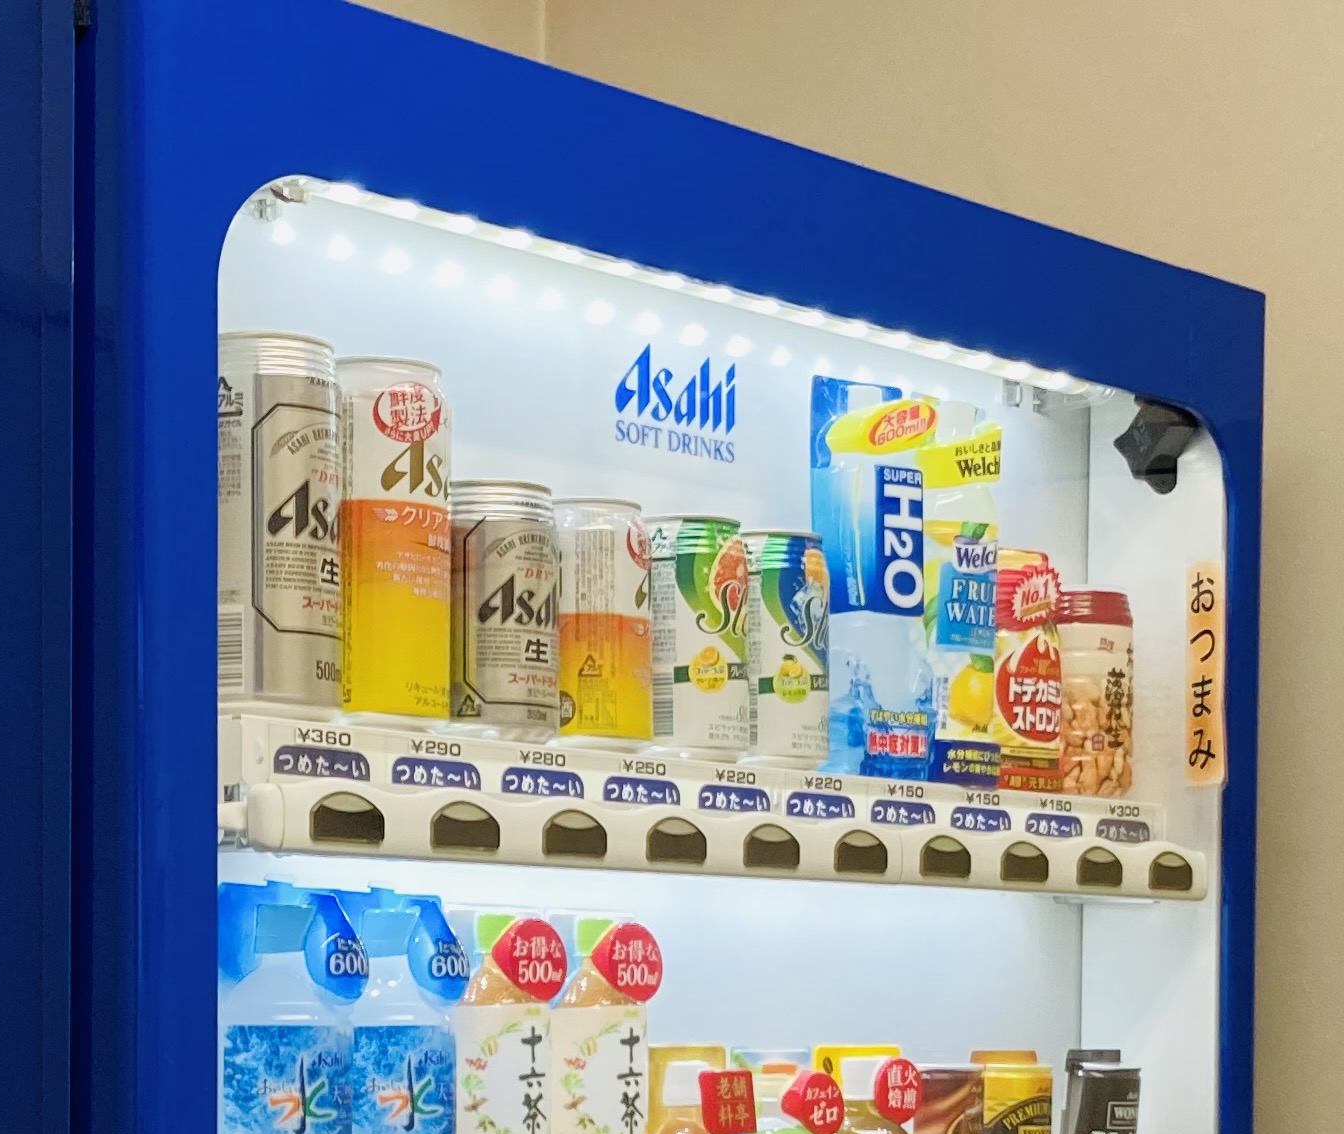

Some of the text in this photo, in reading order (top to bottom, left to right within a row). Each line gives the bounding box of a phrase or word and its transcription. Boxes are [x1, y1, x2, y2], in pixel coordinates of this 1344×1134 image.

[614, 343, 736, 435] Asahi
[883, 404, 920, 430] 大容量
[614, 419, 735, 463] SOFT DRINKS
[381, 440, 449, 500] As
[525, 638, 549, 664] 生
[1189, 572, 1216, 769] おつまみ
[297, 727, 352, 747] ¥360
[411, 739, 462, 757] ¥290
[519, 750, 567, 767] ¥280
[622, 759, 666, 776] ¥250
[715, 768, 757, 785] ¥220
[804, 776, 843, 791] ¥220
[887, 784, 924, 798] ¥150
[965, 791, 1000, 806] ¥150
[1039, 798, 1072, 812] ¥150
[513, 936, 562, 959] お得な
[612, 940, 657, 962] お得な
[887, 1065, 919, 1088] 直火
[719, 1105, 749, 1129] 料亭
[809, 1101, 839, 1126] ゼロ
